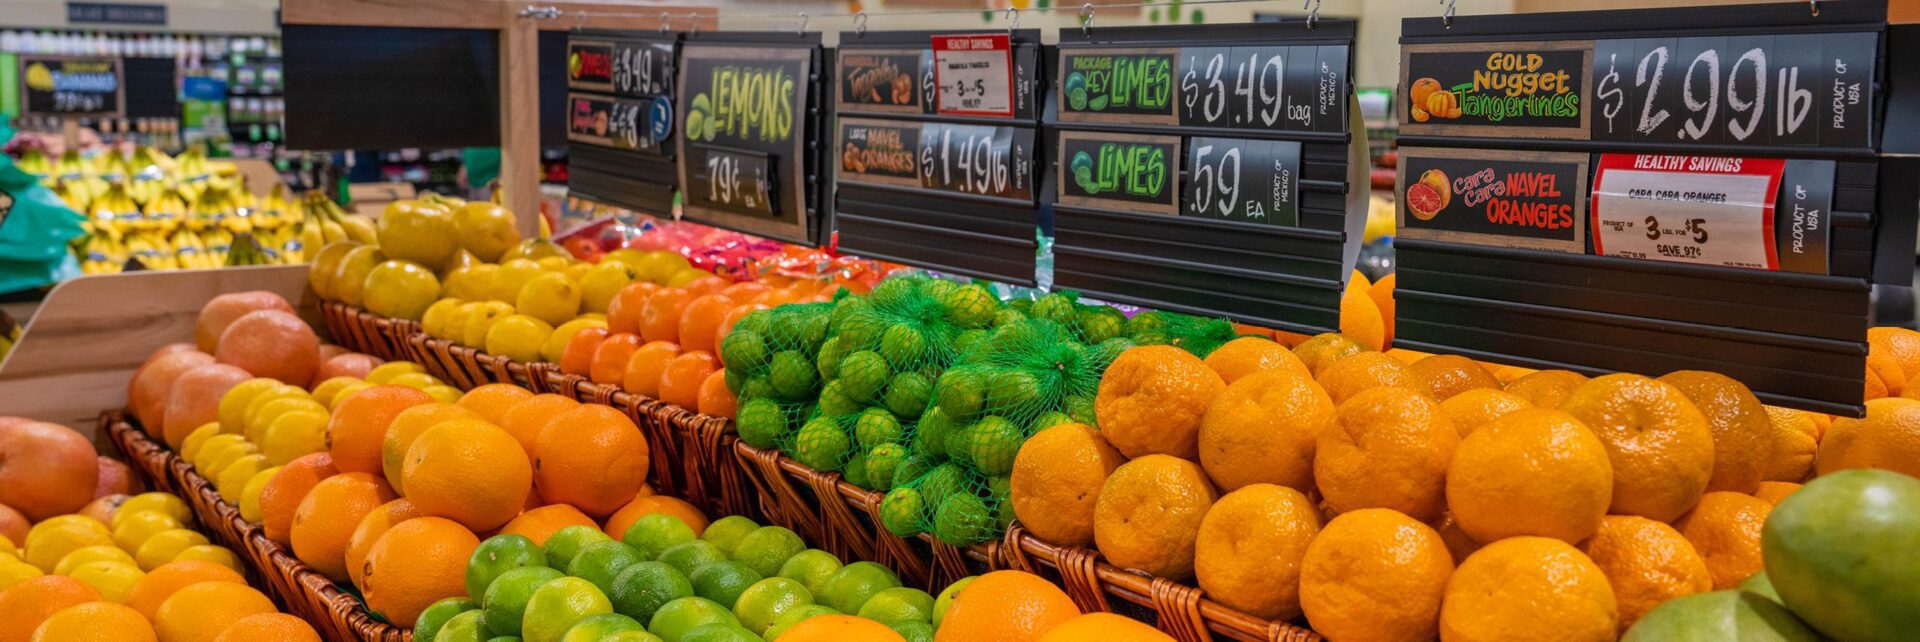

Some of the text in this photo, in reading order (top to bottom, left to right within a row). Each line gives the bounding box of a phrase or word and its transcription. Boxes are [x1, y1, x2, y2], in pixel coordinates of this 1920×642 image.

[1073, 57, 1112, 69] PACKAGE
[1487, 53, 1543, 71] GOLD
[957, 80, 965, 96] 3
[1085, 70, 1111, 93] KEY
[1182, 53, 1311, 126] $3.49 bag
[1320, 62, 1329, 115] PRODUCT OF
[1328, 72, 1337, 106] MEXICO
[1473, 69, 1570, 97] Nugget
[1597, 46, 1812, 141] $2.99 lb
[1833, 59, 1847, 129] PRODUCT OF
[1848, 83, 1861, 105] USA
[711, 66, 794, 142] LEMONS
[1451, 82, 1579, 121] Tangerines
[867, 128, 903, 149] NAVEL
[861, 150, 914, 173] ORANGES
[1275, 159, 1282, 171] OF
[1634, 155, 1743, 172] HEALTHY SAVINGS
[1281, 170, 1290, 202] MEXICO
[1452, 167, 1495, 195] Cara
[1506, 172, 1561, 198] NAVEL
[1464, 181, 1506, 207] Cara
[1628, 189, 1727, 203] CARA CARA ORANGES
[1246, 200, 1265, 218] EA
[1486, 198, 1573, 230] ORANGES
[1793, 185, 1807, 253] PRODUCT OF
[1808, 209, 1819, 230] USA
[1645, 216, 1661, 241] 3
[1657, 244, 1702, 256] SAVE 97¢
